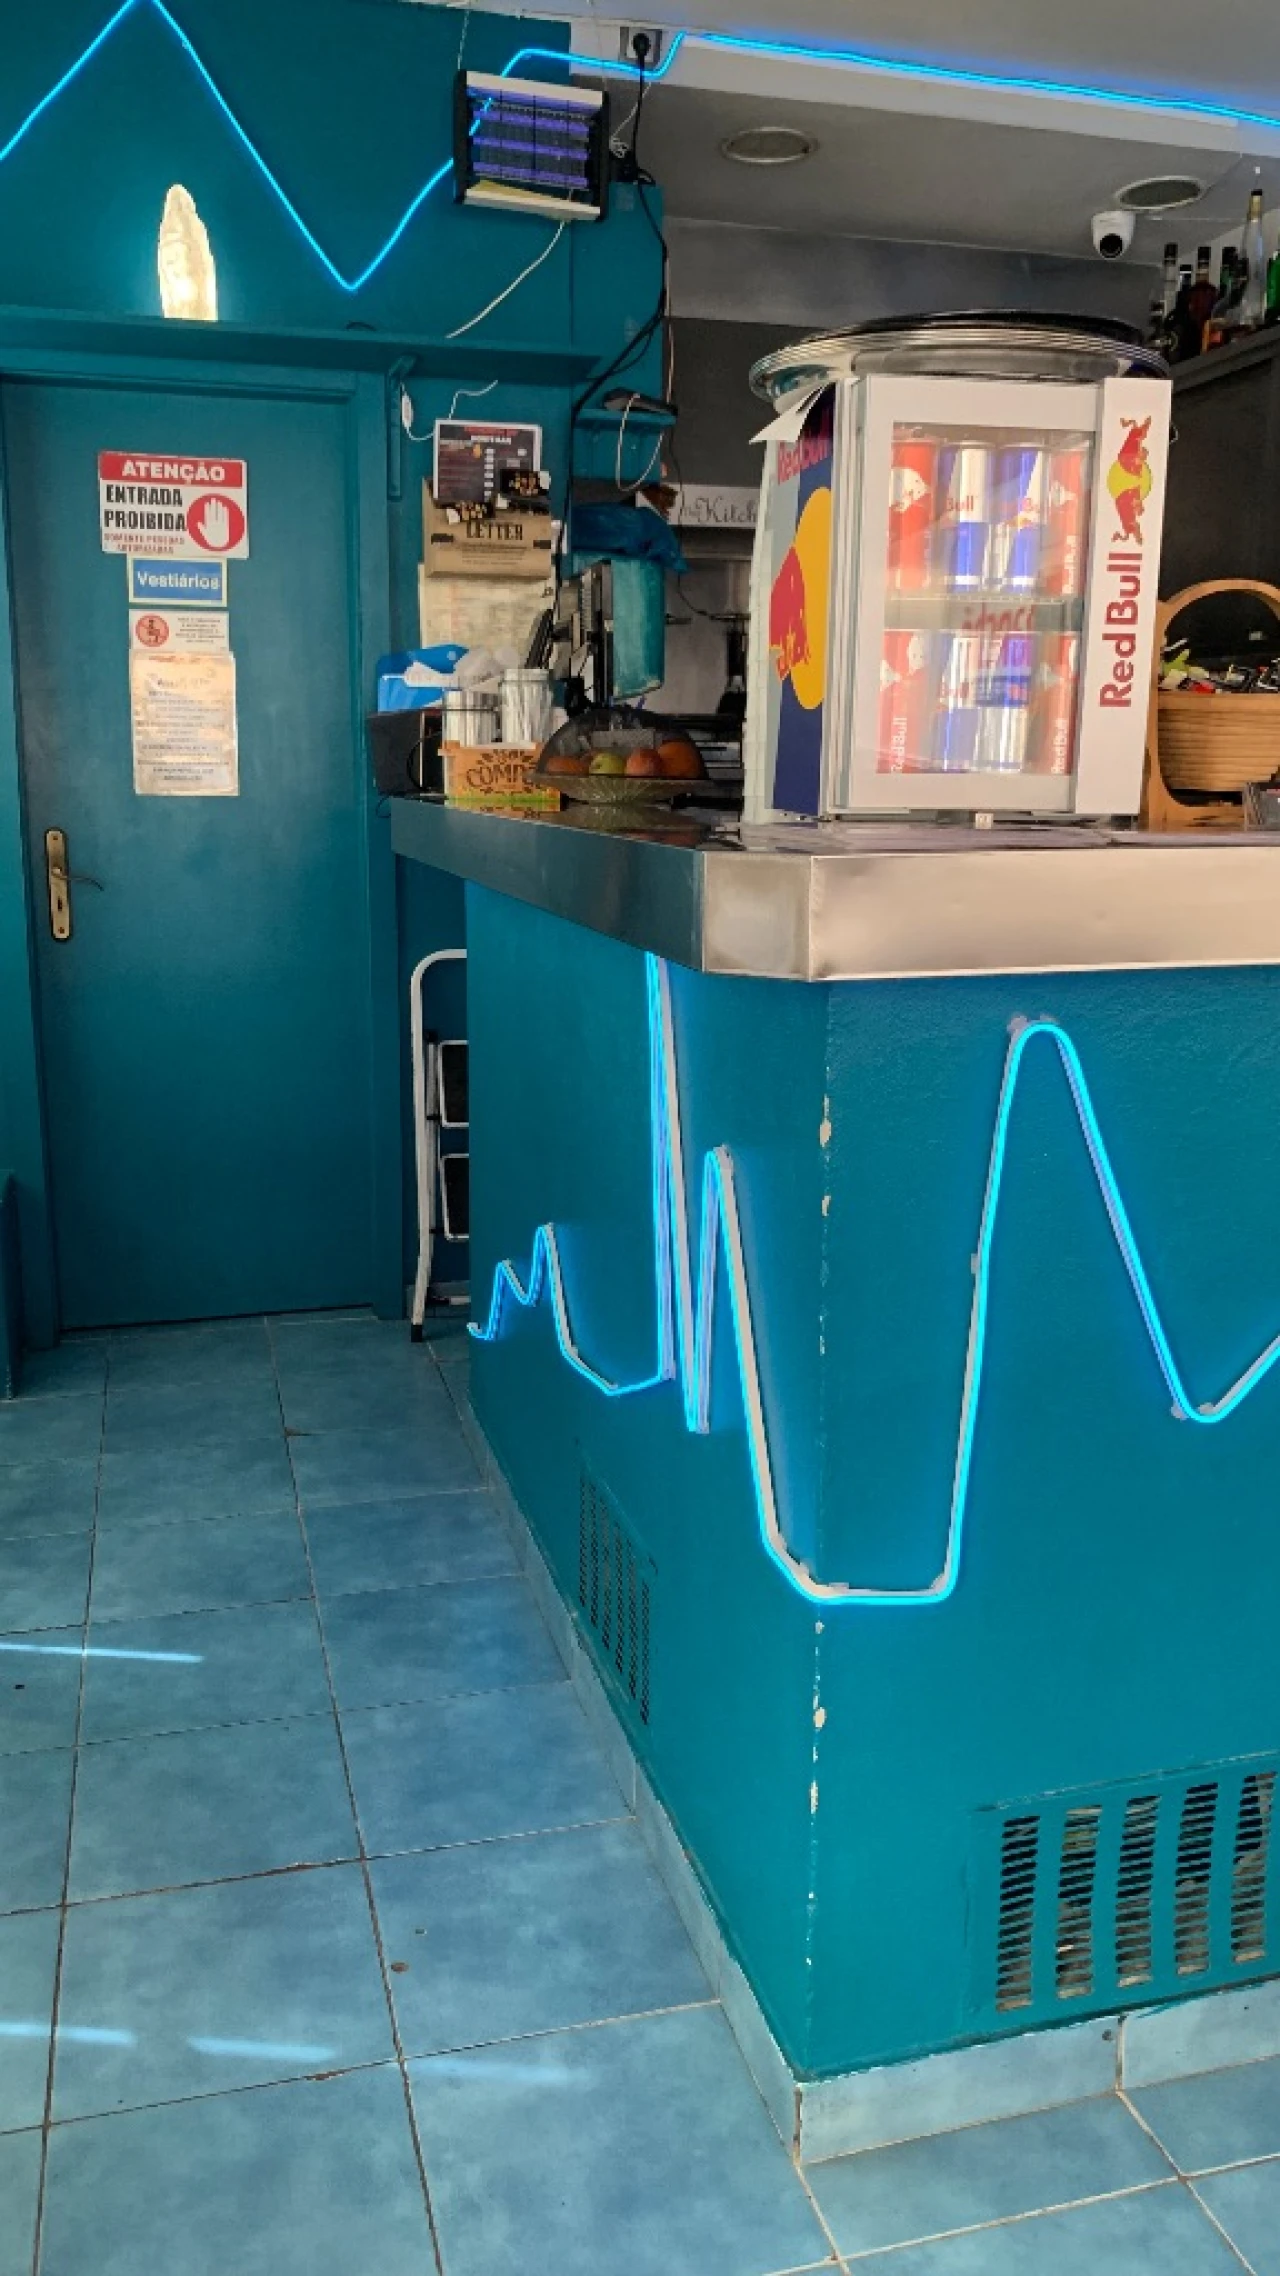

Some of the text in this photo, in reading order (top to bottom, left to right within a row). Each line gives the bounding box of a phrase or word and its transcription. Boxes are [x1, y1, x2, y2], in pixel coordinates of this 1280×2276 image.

[122, 459, 226, 484] ATENÇÃO
[106, 484, 183, 507] ENTRADA
[104, 509, 187, 531] PROIBIDA
[466, 519, 523, 540] LETTER
[137, 570, 220, 590] Vestiários
[1099, 553, 1142, 708] Red Bull
